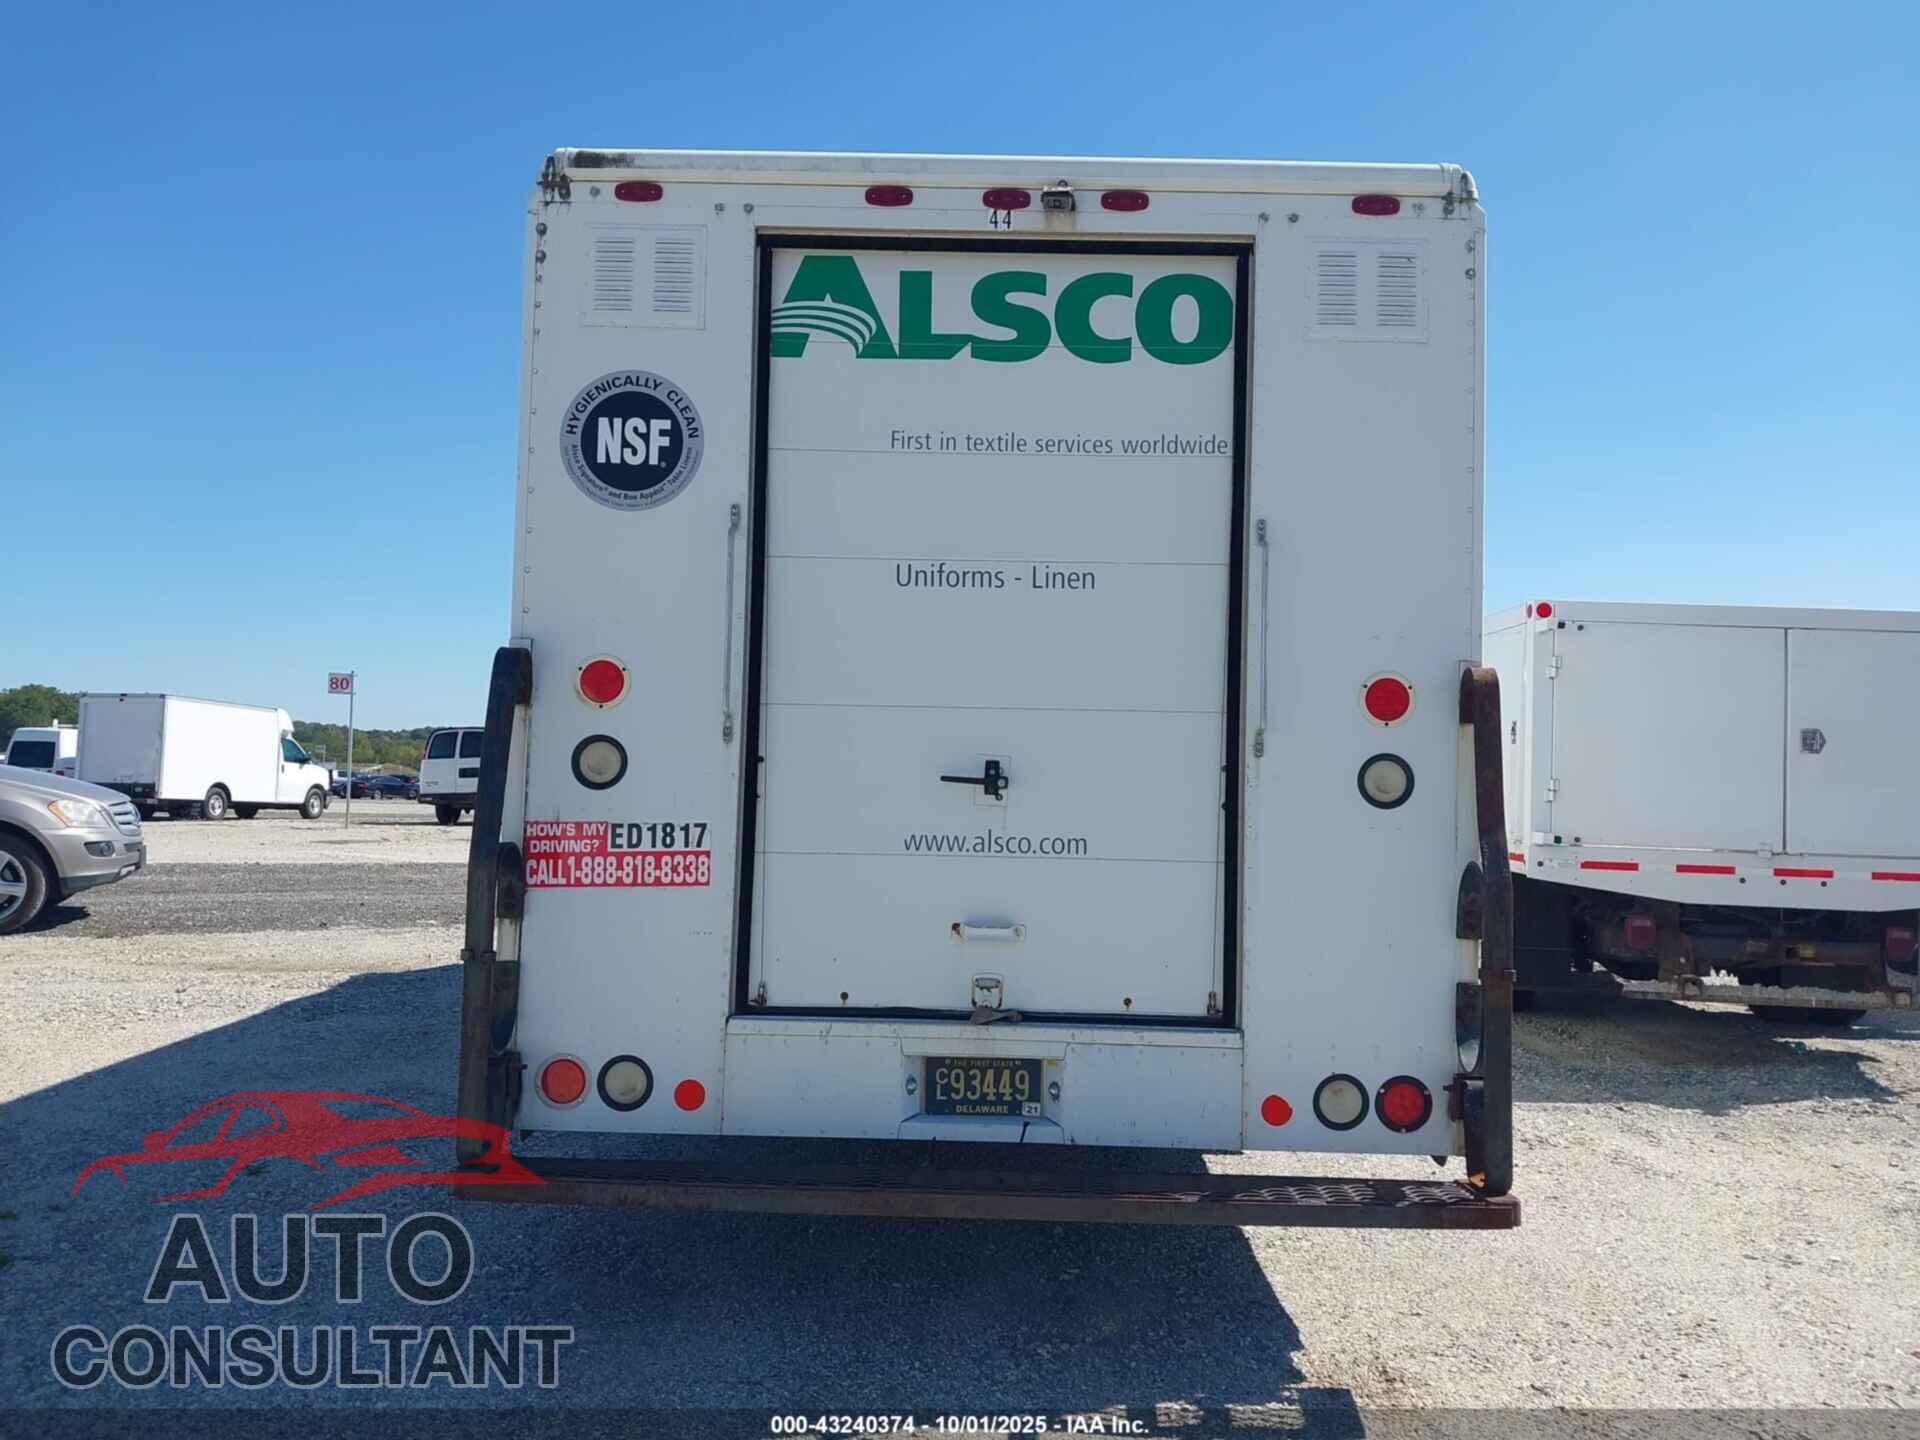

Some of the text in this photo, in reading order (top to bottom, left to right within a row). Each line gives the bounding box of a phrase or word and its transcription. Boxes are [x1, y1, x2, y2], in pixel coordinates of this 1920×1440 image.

[990, 209, 1011, 229] 44
[771, 255, 1234, 365] ALSCO
[565, 375, 700, 439] HYGIENICALLY CLEAN
[596, 416, 672, 466] NSF
[890, 430, 1228, 455] First in textile services worldwide
[896, 562, 1005, 588] Uniforms
[1031, 565, 1096, 589] Linen
[330, 677, 349, 690] 80
[526, 823, 607, 836] HOW'S MY
[904, 829, 1088, 855] www.alsco.com
[530, 840, 600, 853] DRIVING?
[526, 854, 710, 885] CALL 1-888-818-8338
[950, 1068, 1029, 1101] 93449
[955, 1104, 1009, 1114] DELAWARE
